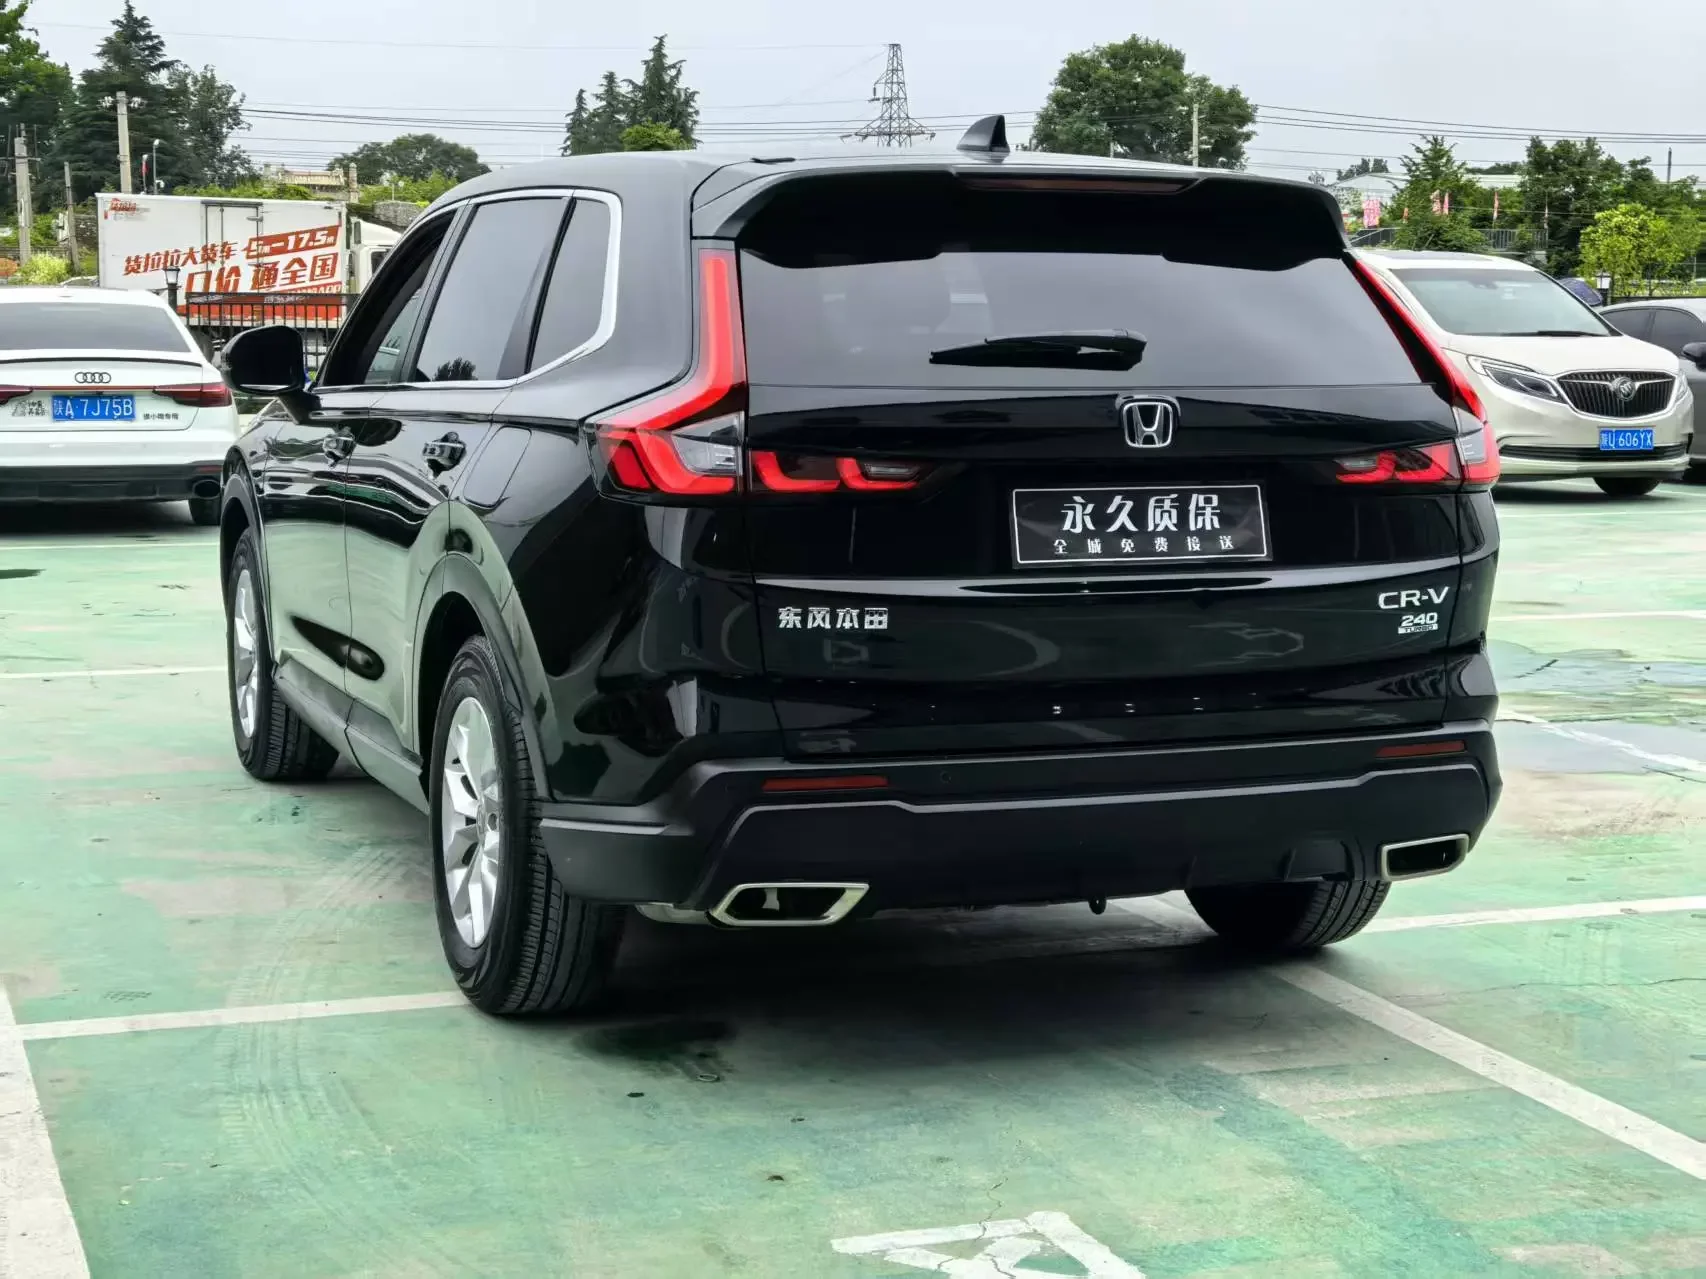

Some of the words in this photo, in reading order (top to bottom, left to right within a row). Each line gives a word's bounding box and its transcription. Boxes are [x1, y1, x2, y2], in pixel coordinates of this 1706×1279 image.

[1061, 494, 1221, 533] 永久质保
[1053, 536, 1235, 554] 全城免费接送
[1378, 586, 1450, 609] CR-V
[777, 606, 889, 629] 东风本田
[1400, 612, 1438, 627] 240
[1404, 625, 1434, 633] TURBO
